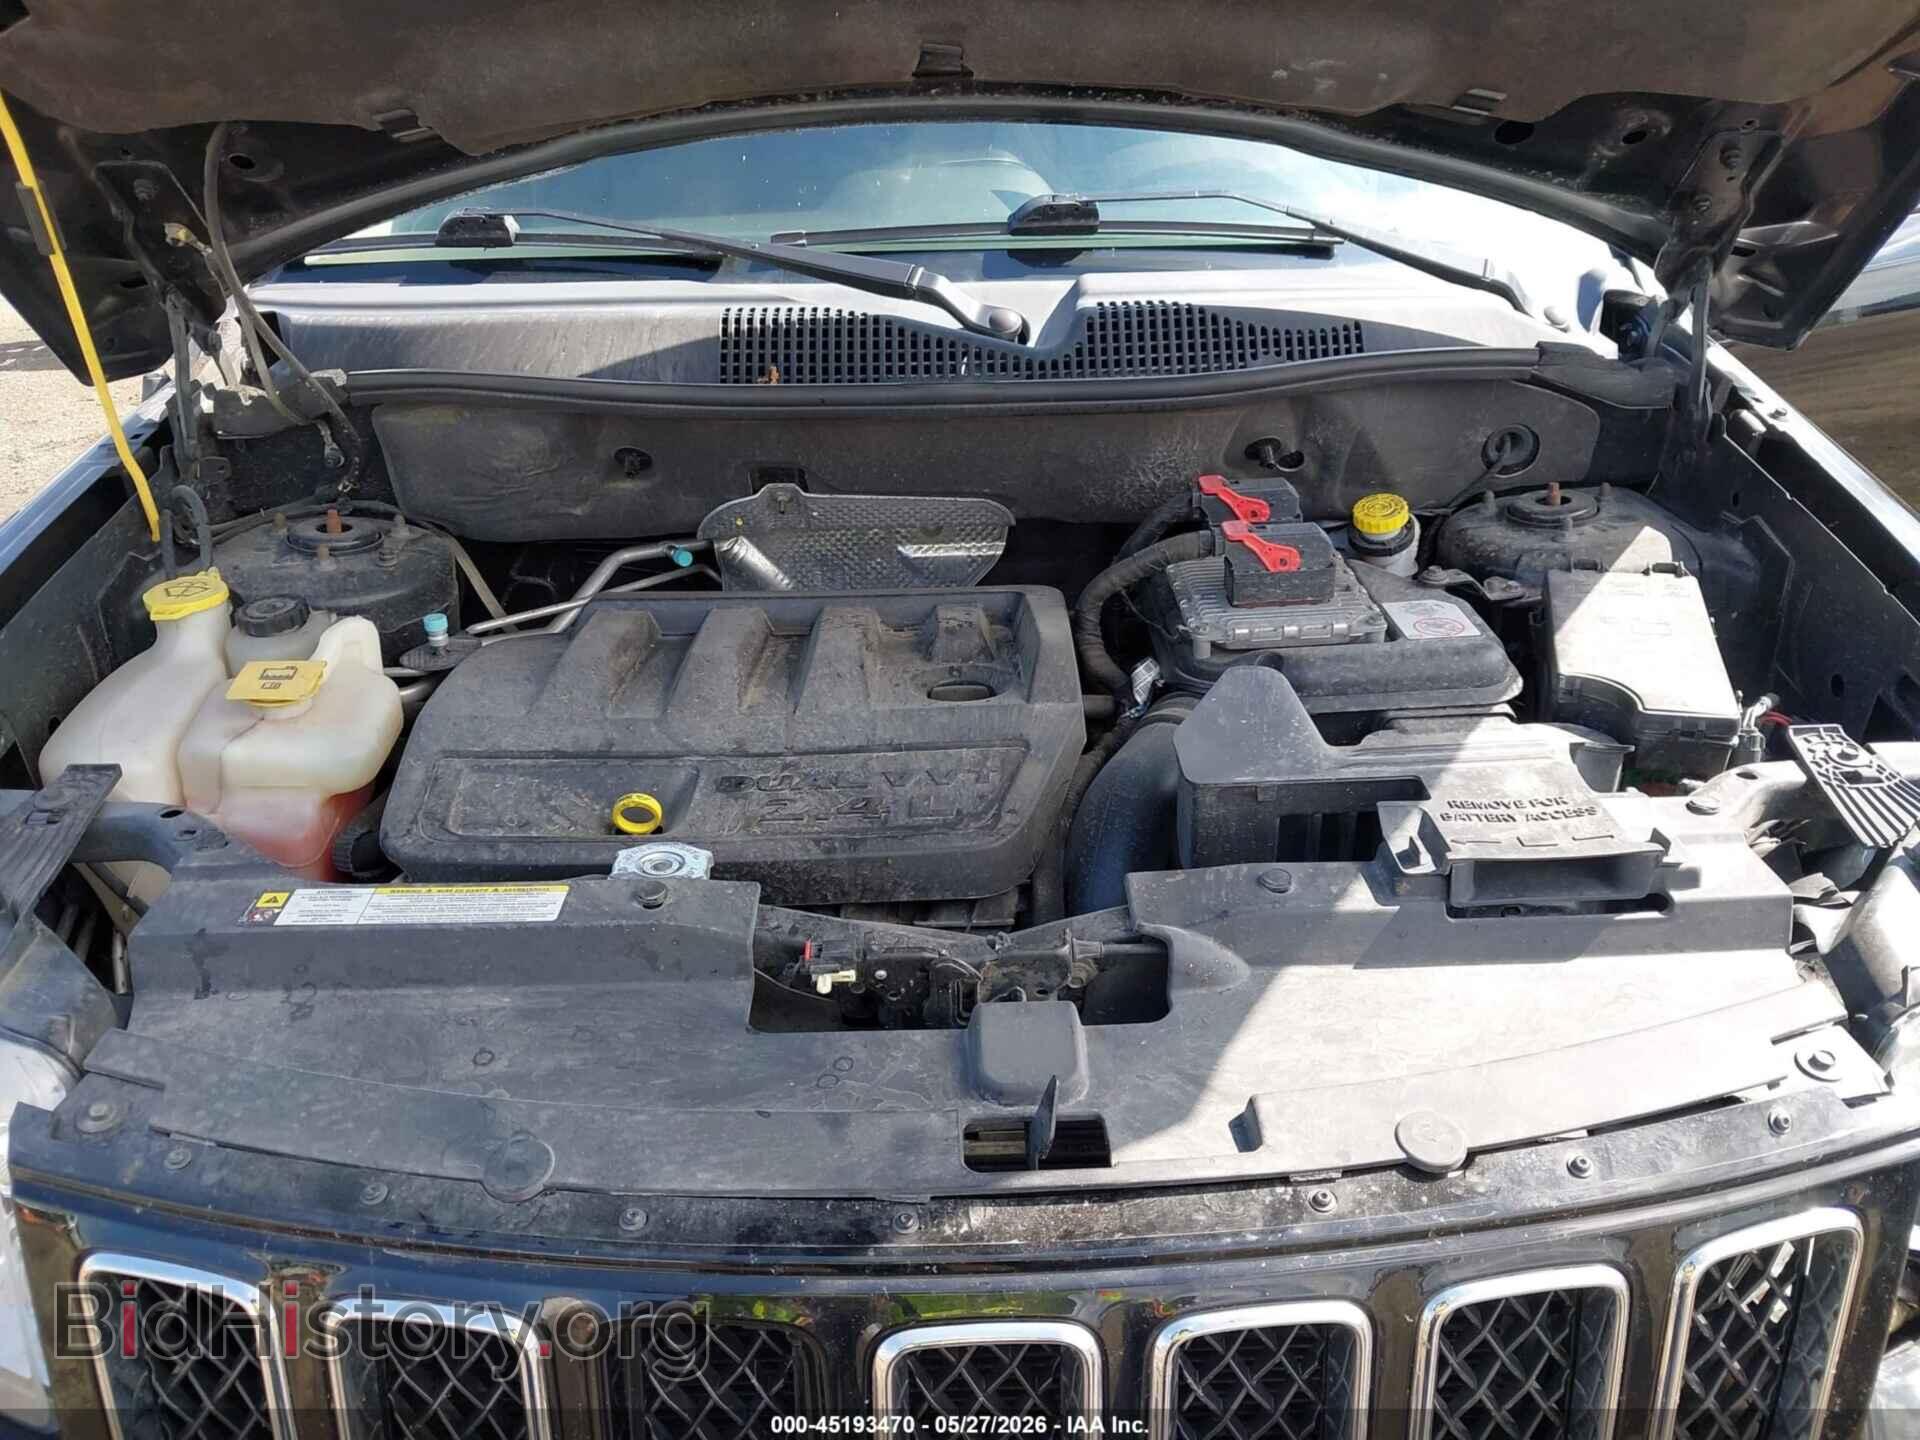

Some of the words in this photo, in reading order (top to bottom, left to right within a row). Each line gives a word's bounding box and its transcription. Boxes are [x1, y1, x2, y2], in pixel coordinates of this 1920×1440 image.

[715, 772, 871, 793] DUAL
[1447, 799, 1525, 810] REMOVE
[1528, 796, 1569, 807] FOR
[1439, 812, 1518, 824] BATTERY
[1525, 806, 1599, 822] ACCESS
